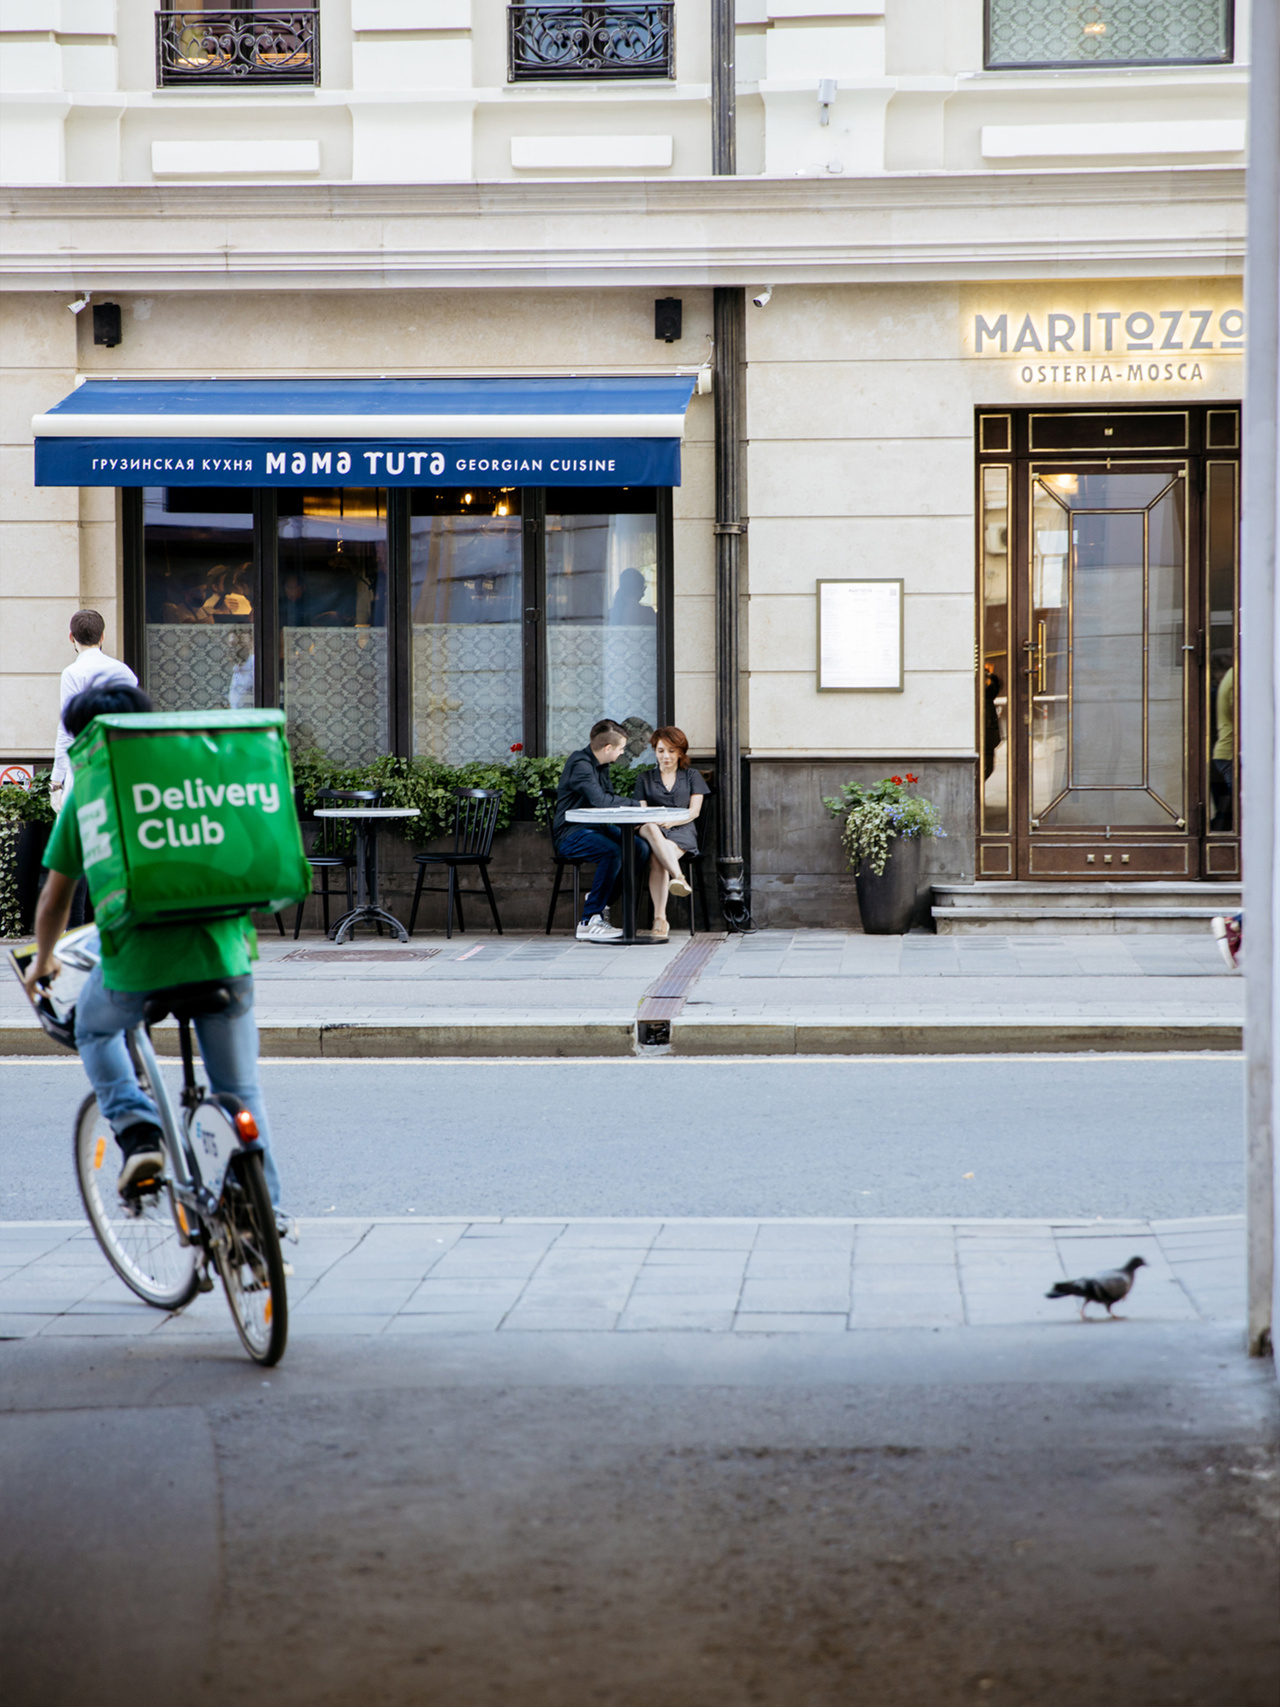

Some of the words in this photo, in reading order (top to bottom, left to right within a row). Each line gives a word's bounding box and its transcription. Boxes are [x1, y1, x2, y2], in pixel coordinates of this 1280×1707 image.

[974, 310, 1245, 353] MARITOZZO
[1021, 363, 1203, 383] OSTERIA-MOSCA
[92, 458, 195, 471] ГРУЗИНСКАЯ
[202, 458, 253, 471] КУХНЯ
[456, 459, 543, 472] GEORGIAN
[550, 459, 616, 472] CUISINE
[132, 777, 281, 813] Delivery
[137, 815, 225, 849] Club
